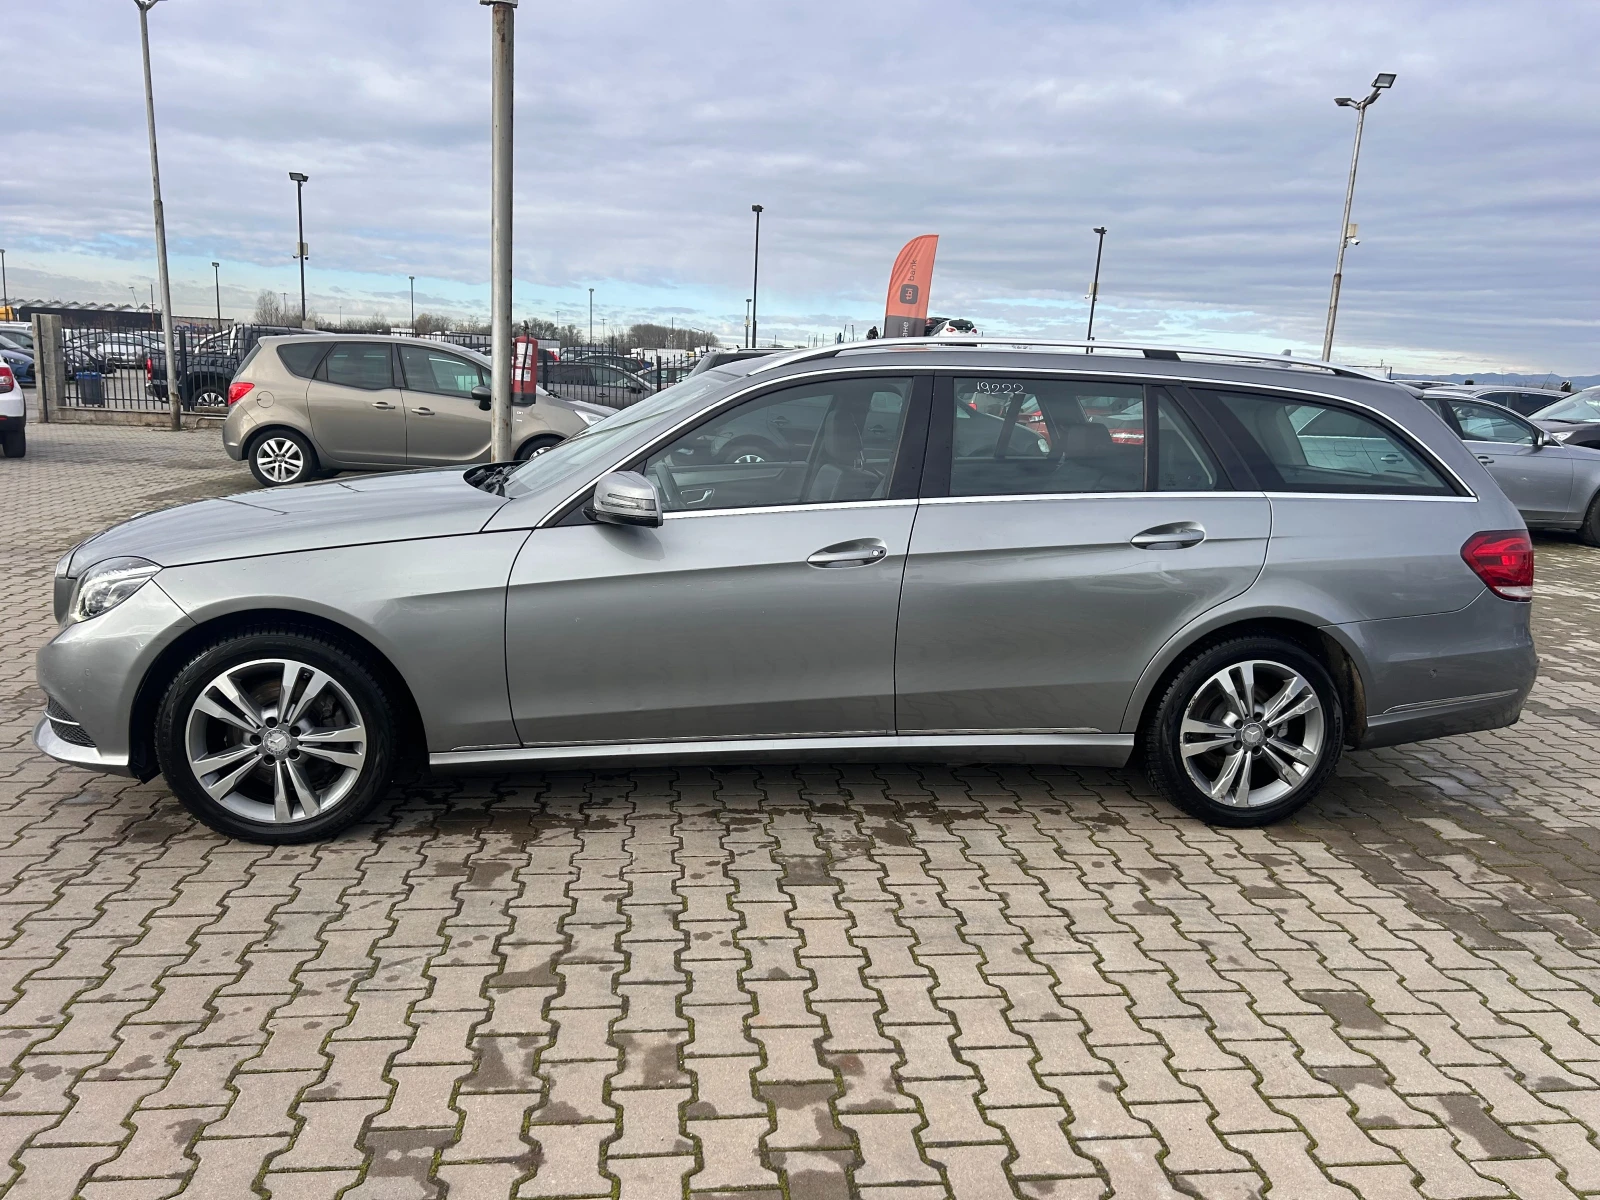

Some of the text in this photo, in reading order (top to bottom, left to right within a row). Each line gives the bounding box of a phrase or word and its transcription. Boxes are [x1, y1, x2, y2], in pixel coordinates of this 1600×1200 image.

[905, 260, 917, 300] tbi bank
[976, 381, 1024, 394] 19222
